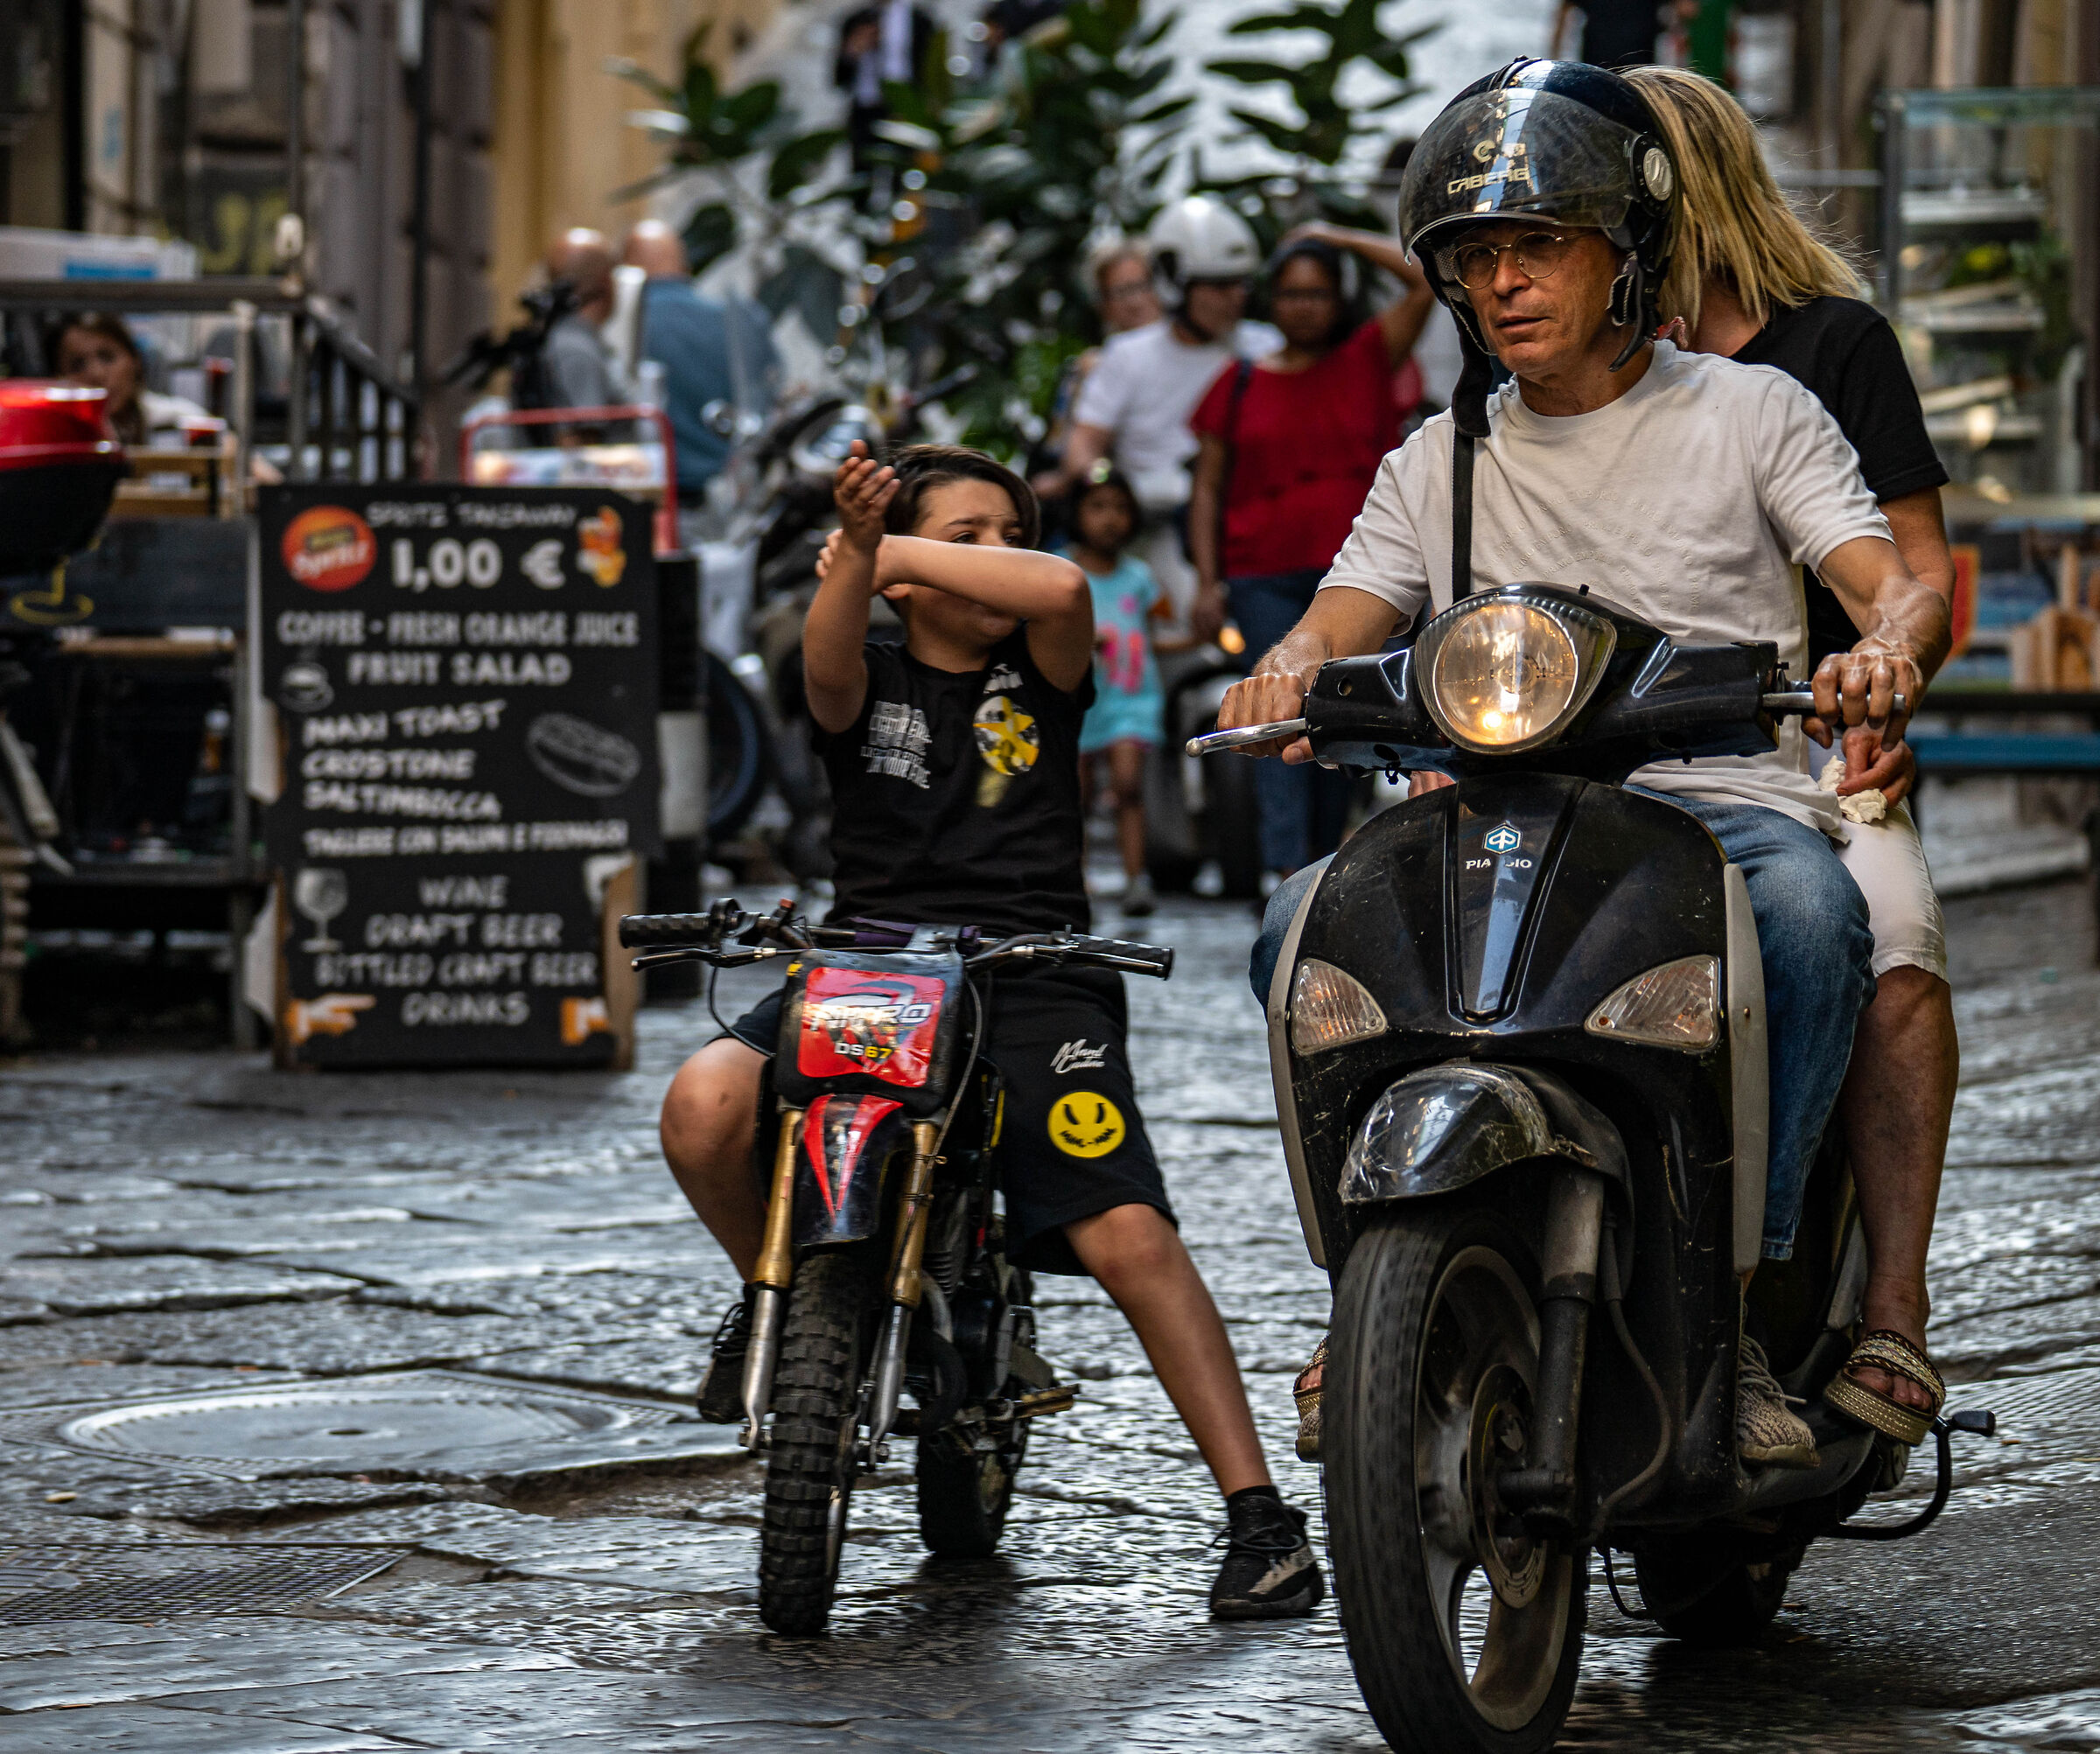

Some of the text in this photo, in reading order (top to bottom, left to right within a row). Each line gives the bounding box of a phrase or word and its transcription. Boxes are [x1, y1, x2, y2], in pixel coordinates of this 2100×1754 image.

[1447, 168, 1530, 195] CABERG
[394, 540, 564, 590] 1,00 €
[278, 611, 639, 645] COFFEE FRESH ORANGE JUICE
[350, 653, 570, 684] FRUIT SALAD
[304, 701, 506, 746] MAXI TOAST
[304, 750, 476, 777] CROSTONE
[1466, 858, 1532, 870] PIAIO
[421, 877, 508, 907] WINE
[483, 914, 563, 946] BEER
[316, 953, 598, 985] BOTTLED CRAFT BEER
[402, 992, 529, 1024] DRINKS
[834, 1042, 893, 1059] DS67
